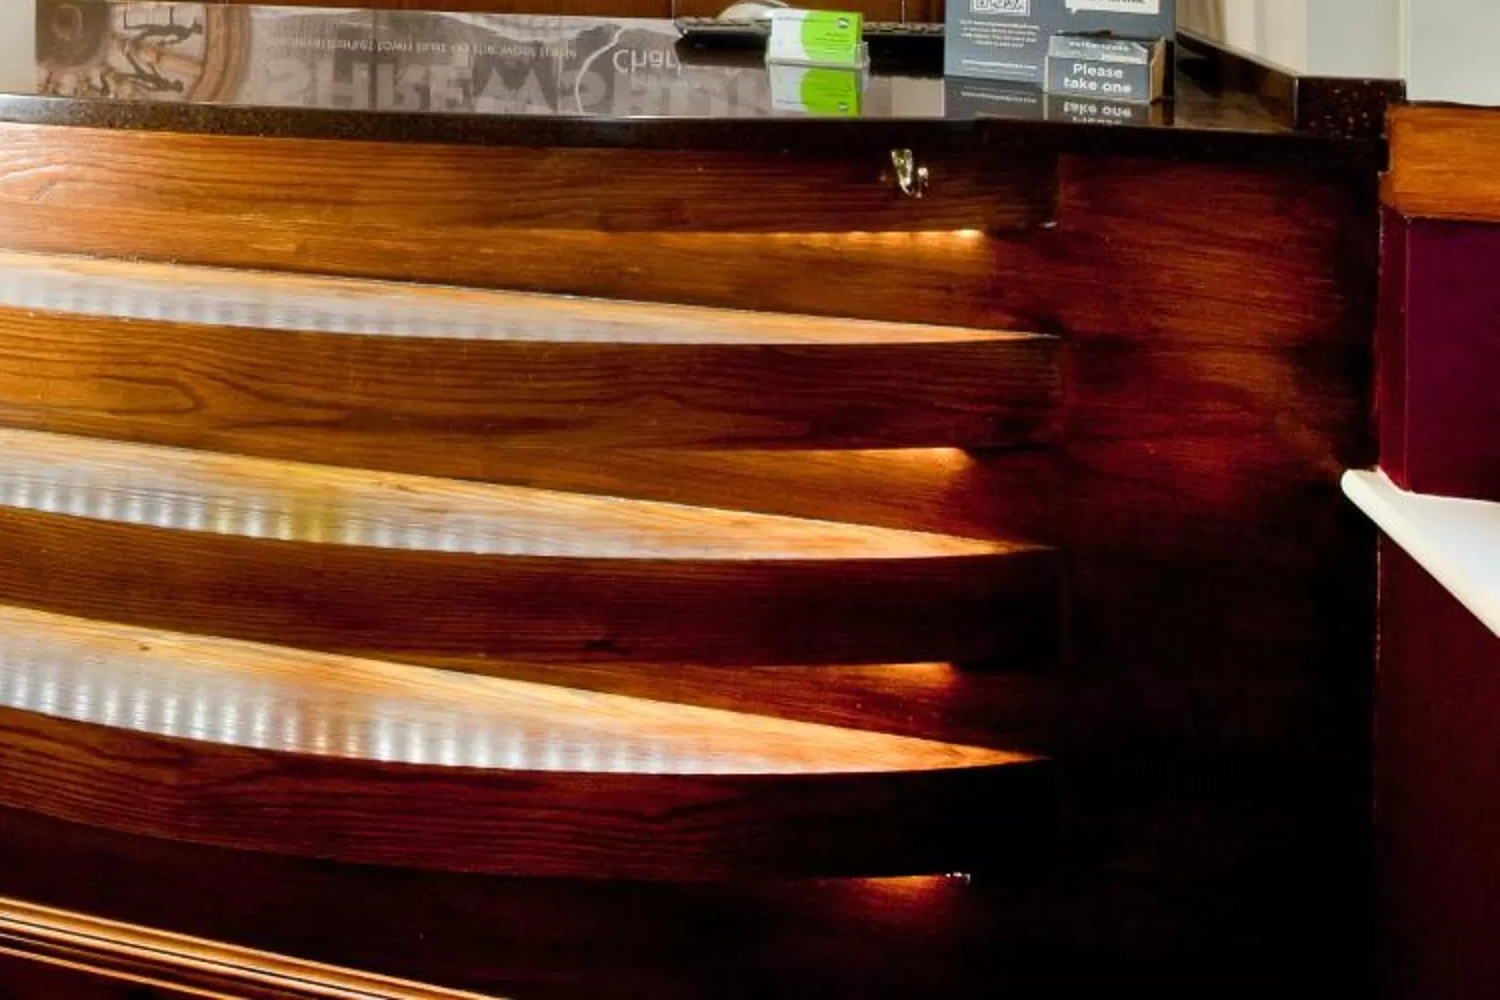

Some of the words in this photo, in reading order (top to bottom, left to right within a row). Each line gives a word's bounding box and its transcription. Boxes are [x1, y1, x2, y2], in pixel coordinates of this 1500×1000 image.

[1073, 63, 1124, 79] Please
[1063, 77, 1098, 92] take
[1101, 82, 1132, 93] one
